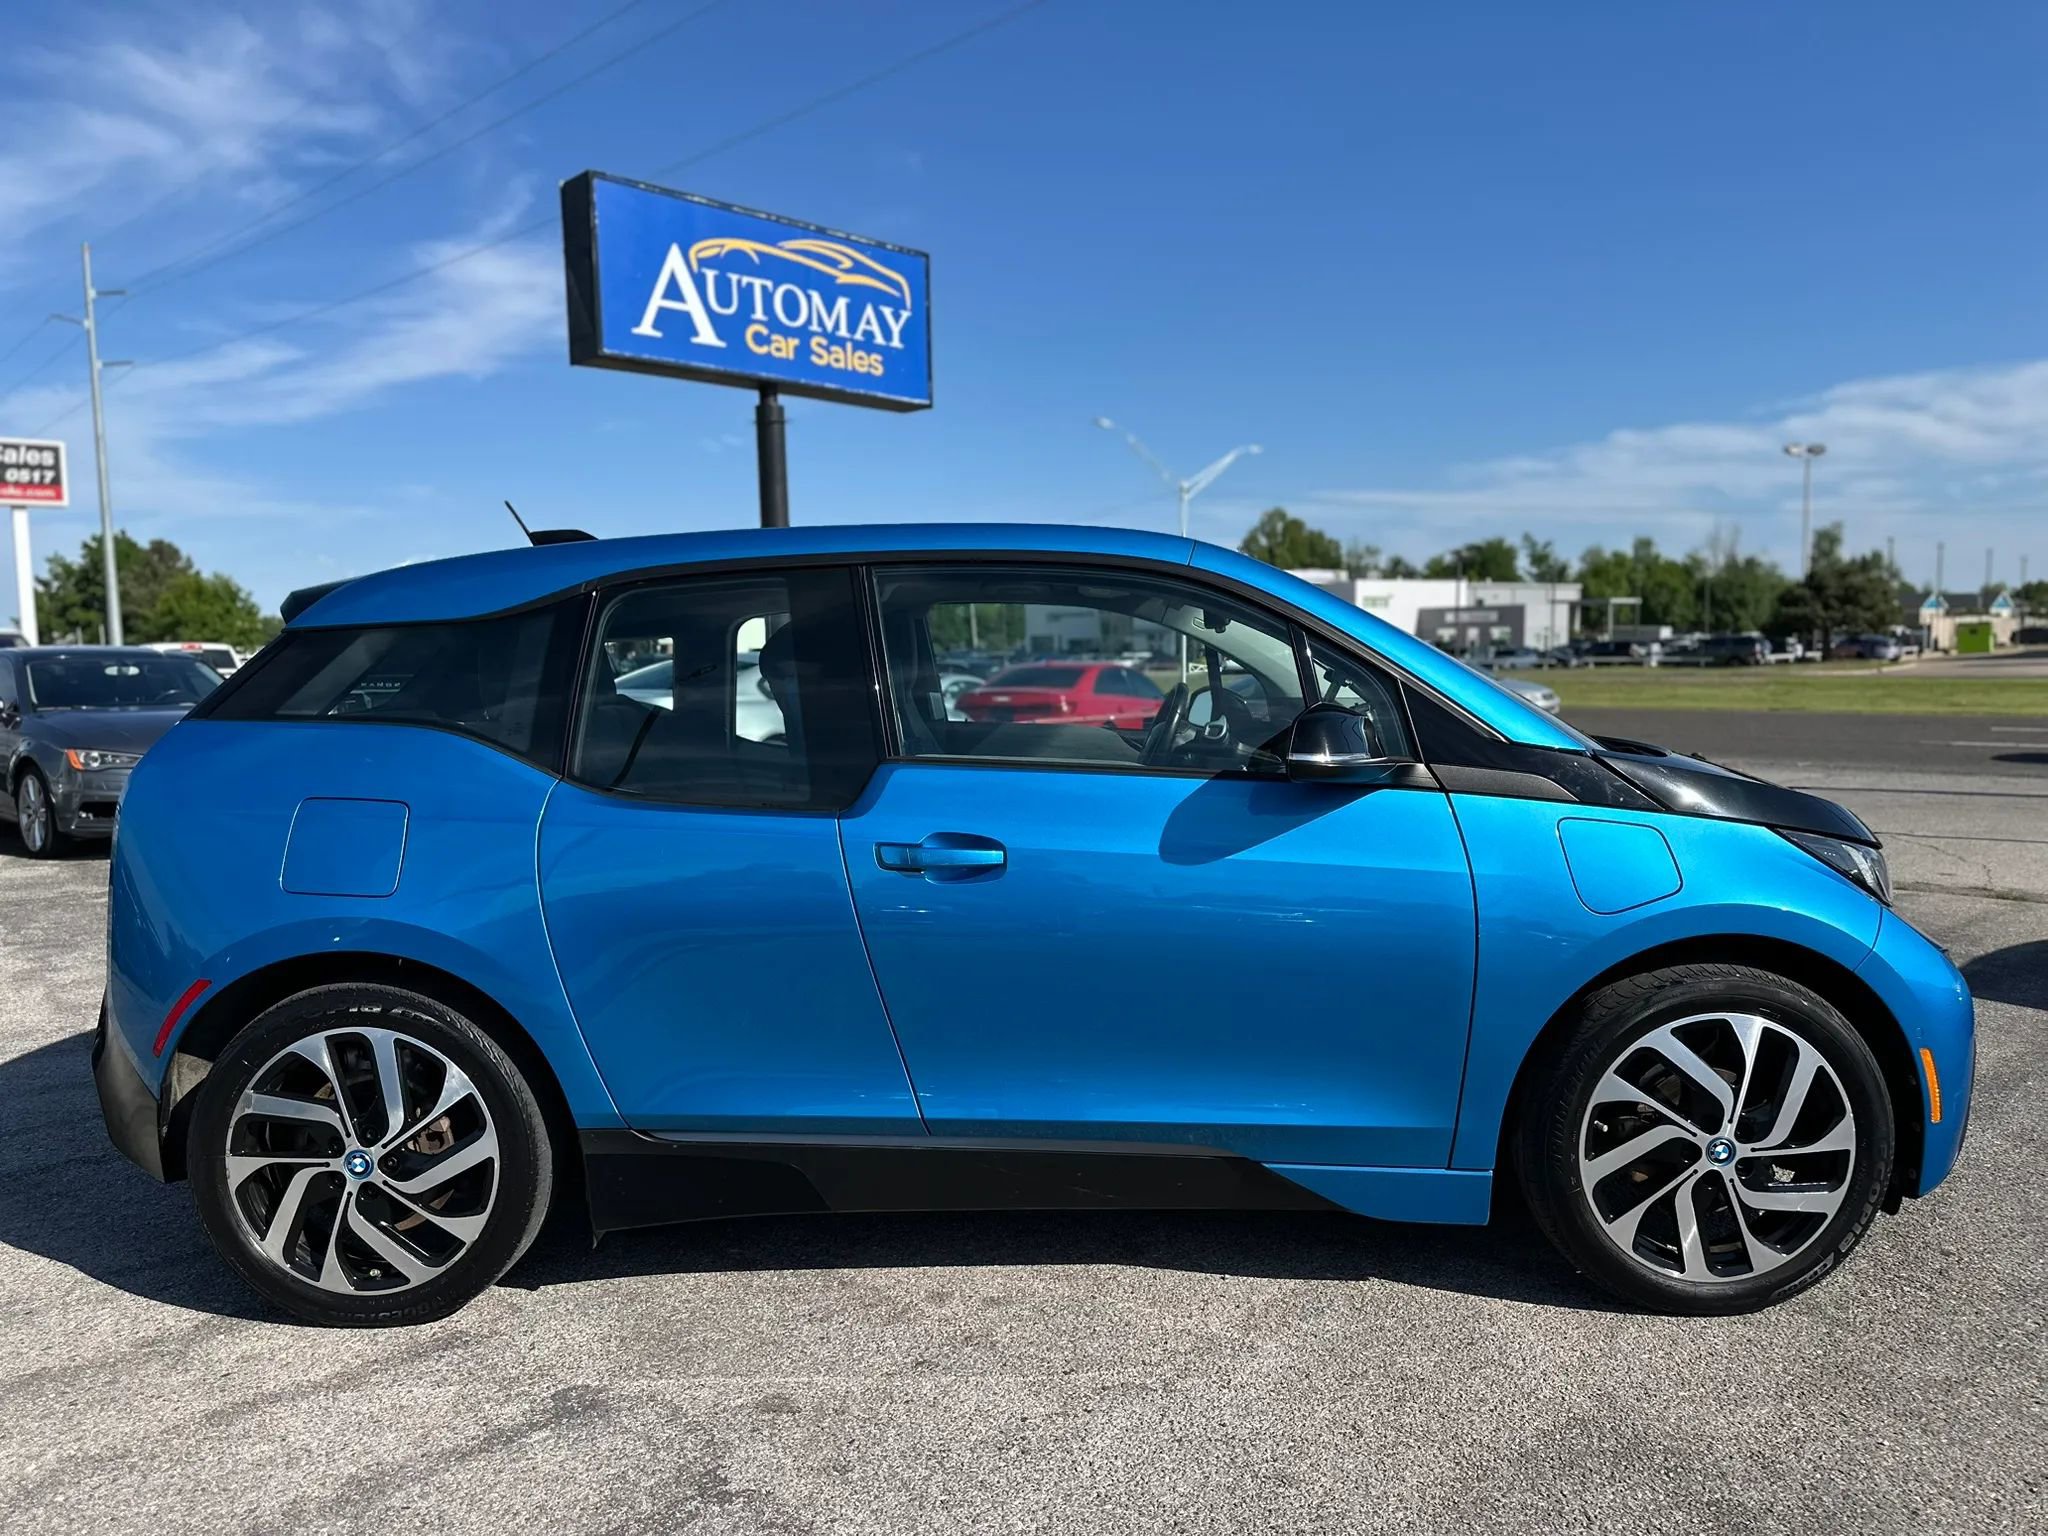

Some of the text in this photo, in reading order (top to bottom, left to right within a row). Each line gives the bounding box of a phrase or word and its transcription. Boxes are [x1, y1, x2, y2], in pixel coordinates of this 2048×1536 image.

[631, 242, 912, 349] AUTOMAY
[745, 323, 885, 377] Car Sales
[0, 445, 55, 467] ales
